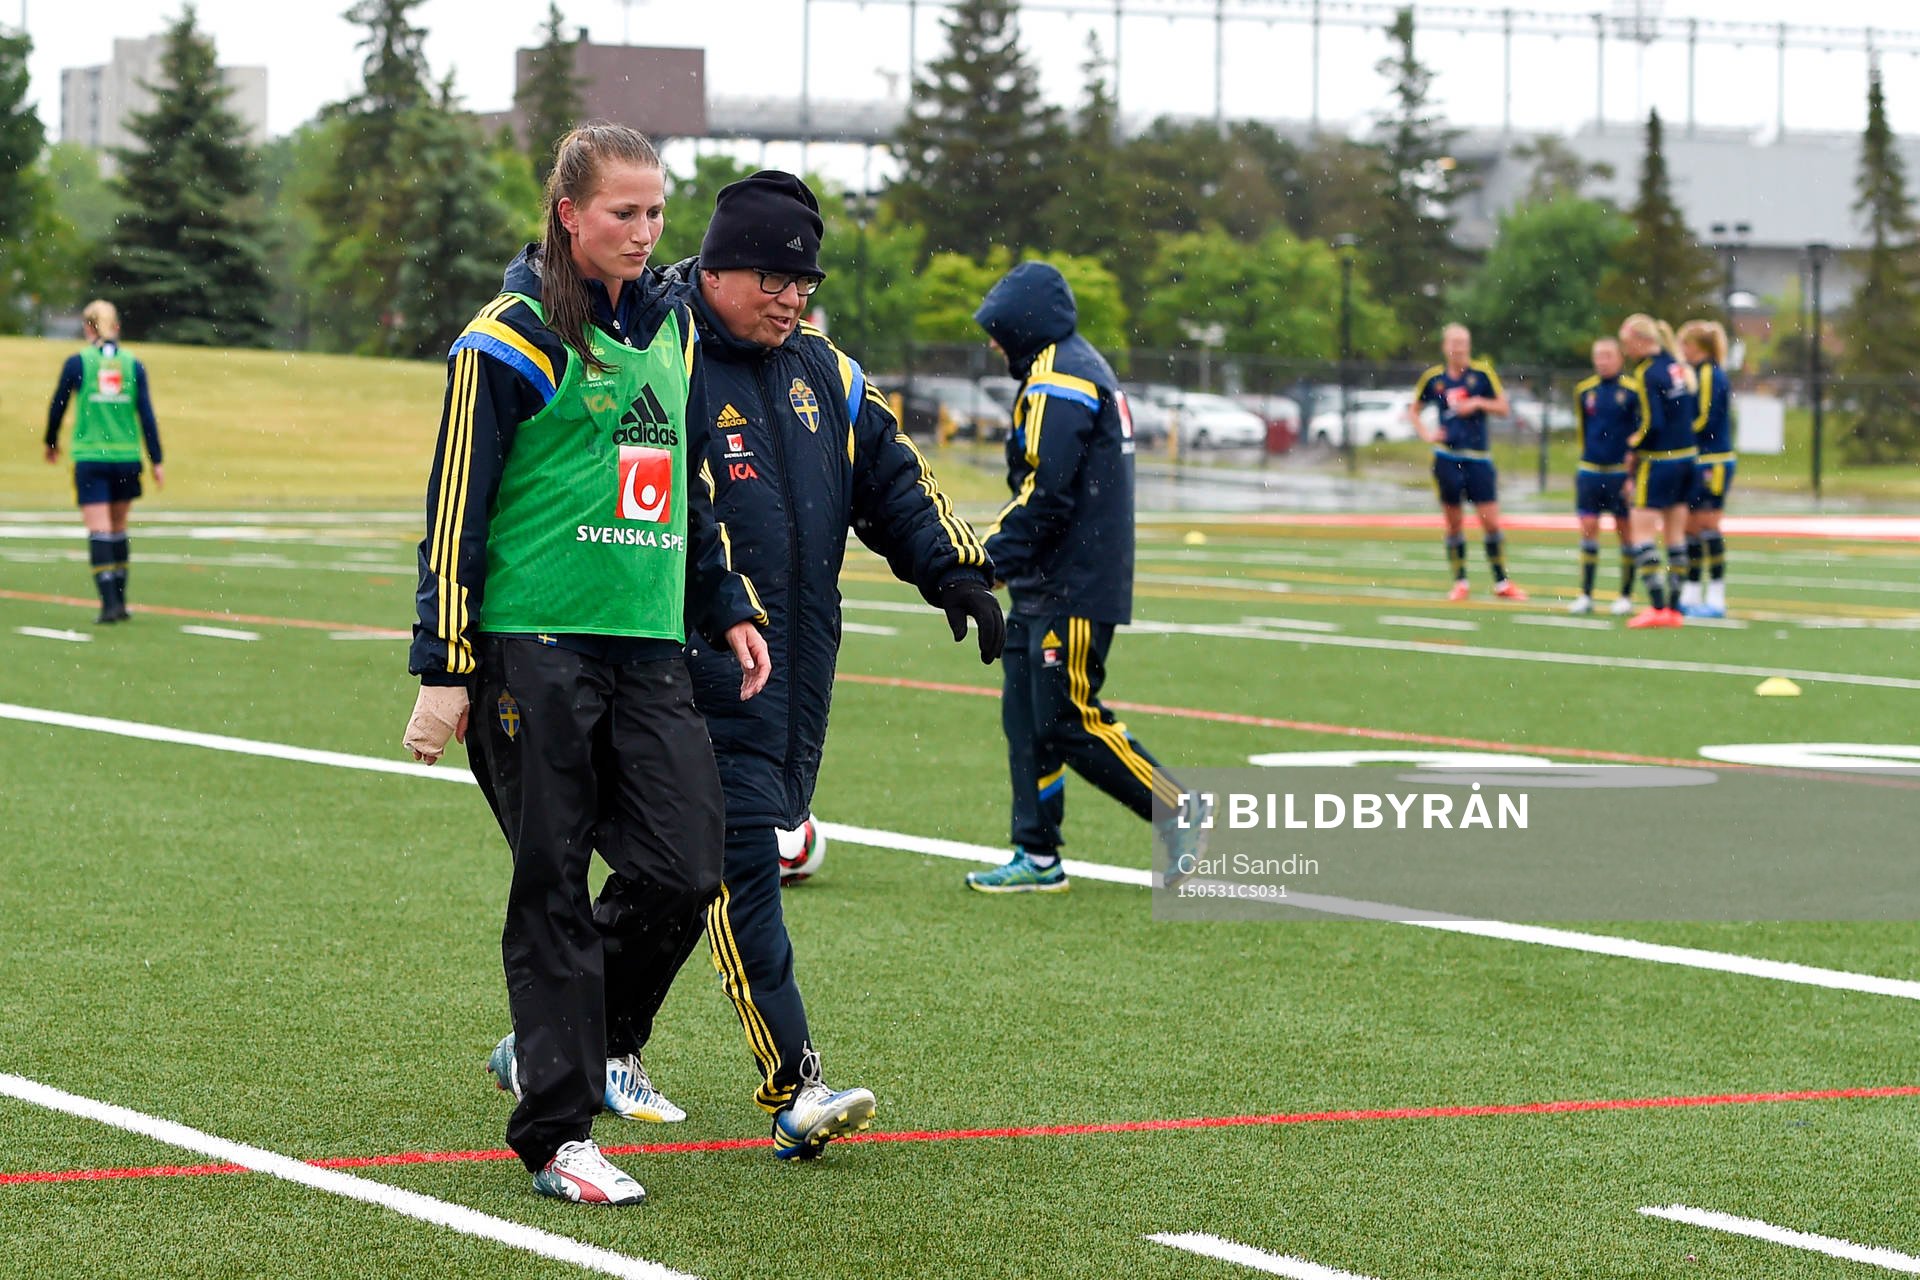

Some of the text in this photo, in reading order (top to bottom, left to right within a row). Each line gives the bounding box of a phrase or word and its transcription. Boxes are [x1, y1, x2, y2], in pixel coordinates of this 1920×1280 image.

[716, 417, 748, 428] adidas
[612, 421, 679, 446] adidas
[728, 462, 759, 481] ICA
[576, 525, 658, 548] SVENSKA
